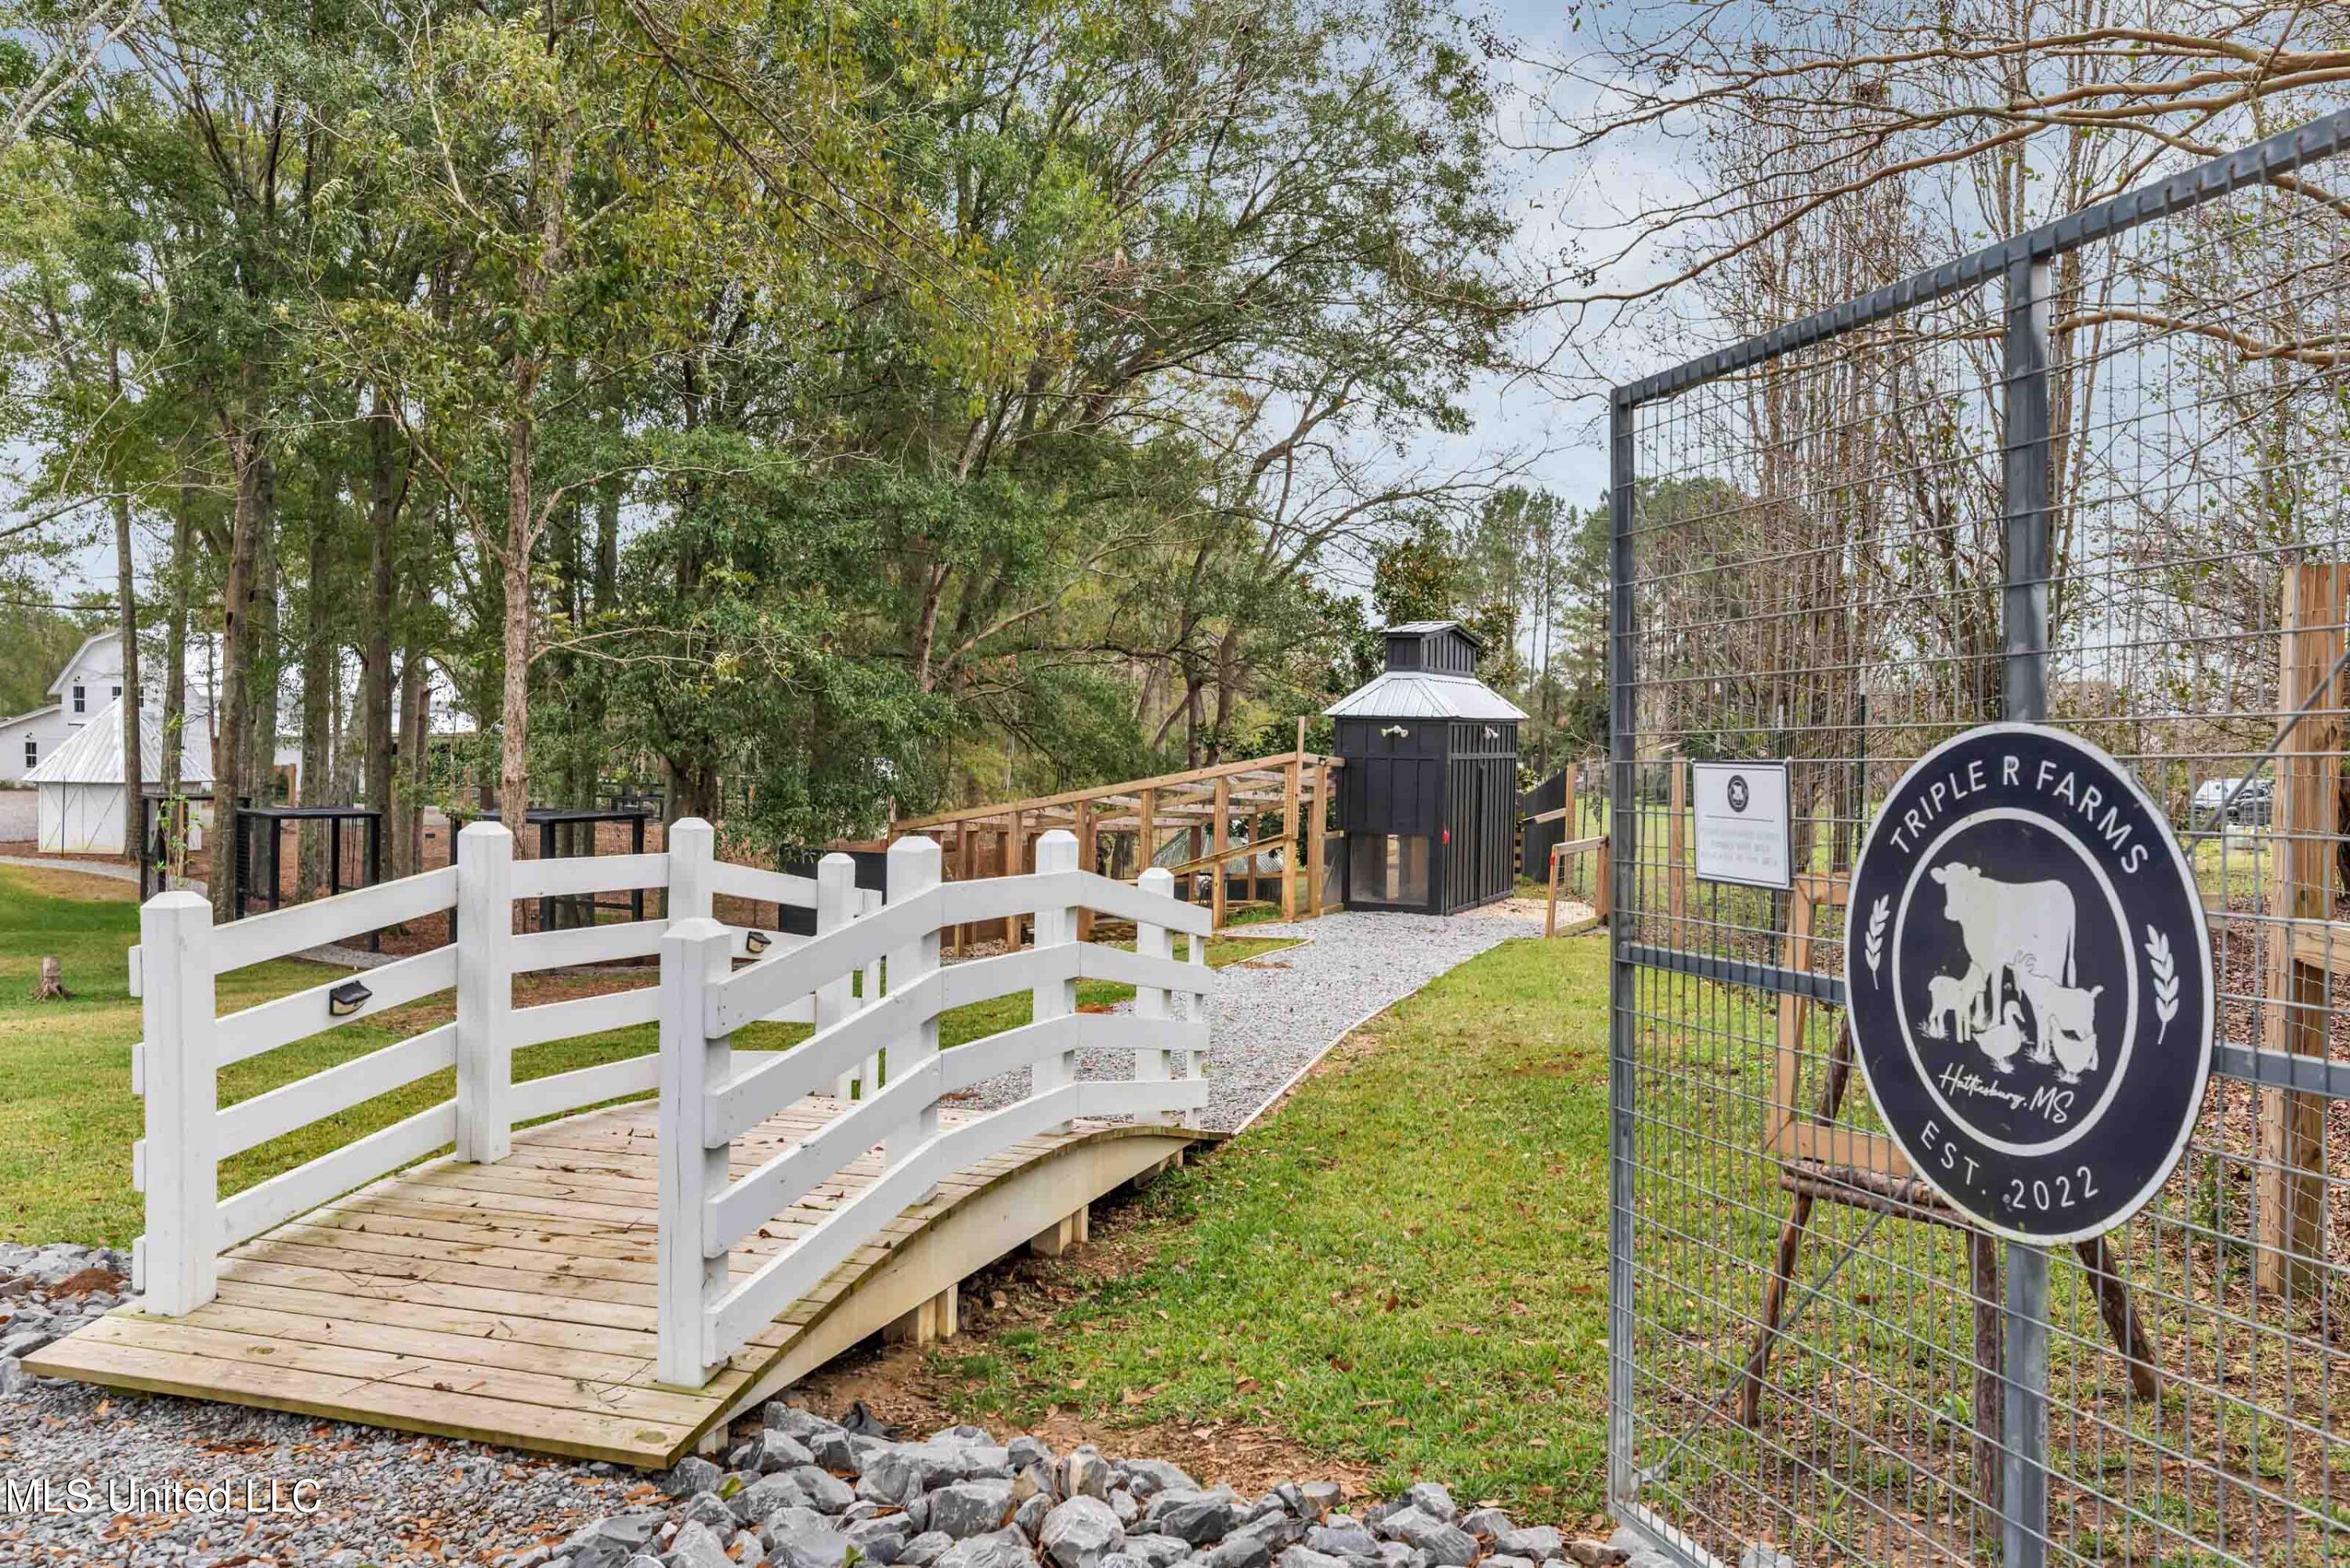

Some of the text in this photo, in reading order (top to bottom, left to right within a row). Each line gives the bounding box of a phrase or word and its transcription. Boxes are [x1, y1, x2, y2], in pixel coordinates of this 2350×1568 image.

[1890, 756, 2148, 873] TRIPLE R FARMS
[2029, 1086, 2075, 1124] MS
[1921, 1120, 2099, 1210] EST. 2022
